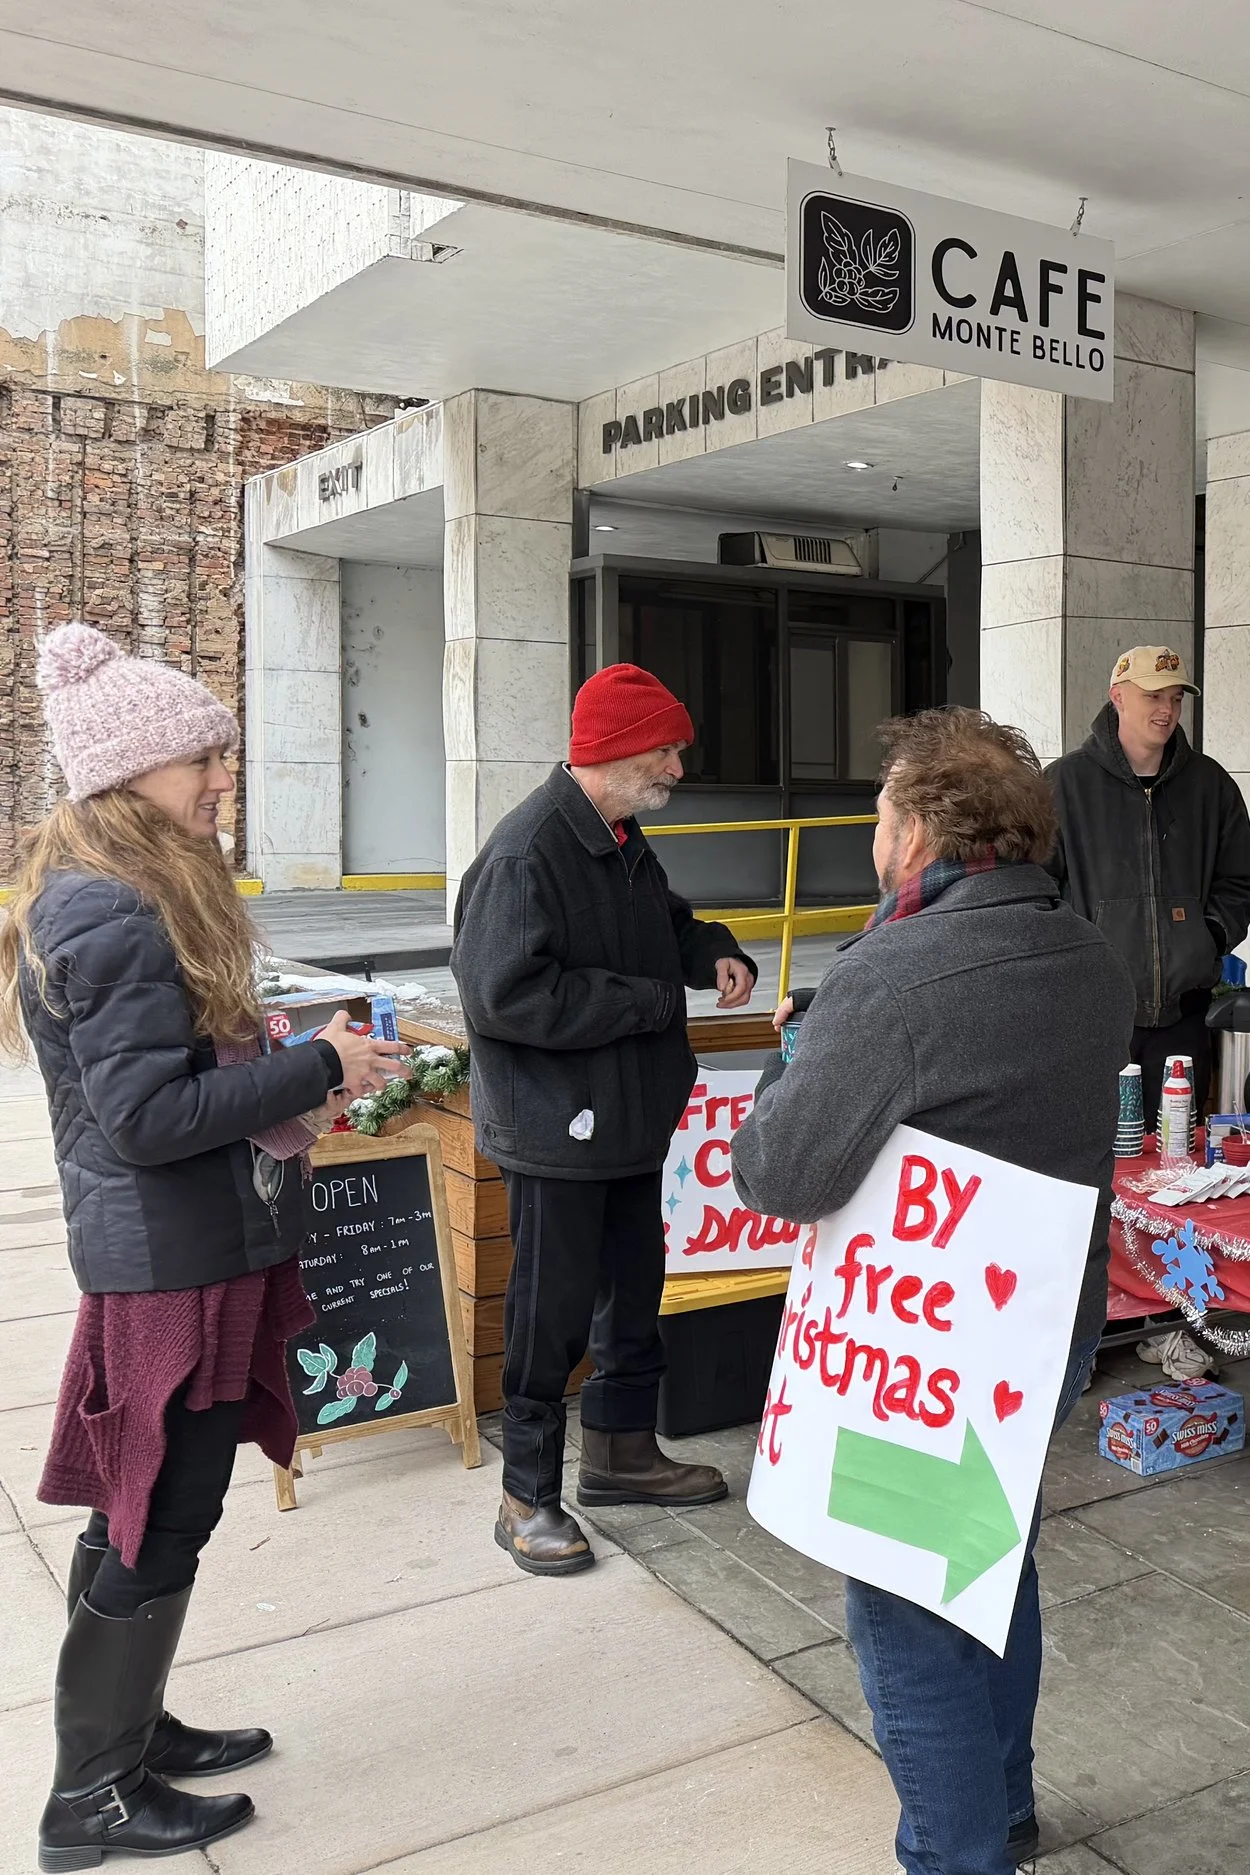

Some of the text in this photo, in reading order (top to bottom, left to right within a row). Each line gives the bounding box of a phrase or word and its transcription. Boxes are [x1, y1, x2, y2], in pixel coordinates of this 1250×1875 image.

[932, 237, 1106, 341] CAFE
[931, 311, 1105, 373] MONTE BELLO
[602, 346, 905, 455] PARKING ENTR
[318, 460, 362, 501] EXIT
[269, 1018, 291, 1035] 50
[312, 1174, 379, 1212] OPEN
[892, 1154, 983, 1249] BY
[336, 1220, 376, 1238] FRIDAY
[298, 1253, 343, 1270] ATURDAY:
[325, 1285, 344, 1296] AND
[349, 1277, 366, 1288] TRY
[376, 1271, 393, 1282] ONE
[402, 1266, 413, 1276] OF
[419, 1262, 435, 1272] OUR
[321, 1278, 410, 1312] CURRENT SPECIALS!
[834, 1231, 956, 1333] free
[778, 1296, 960, 1428] ristmas
[1145, 1422, 1157, 1434] 50
